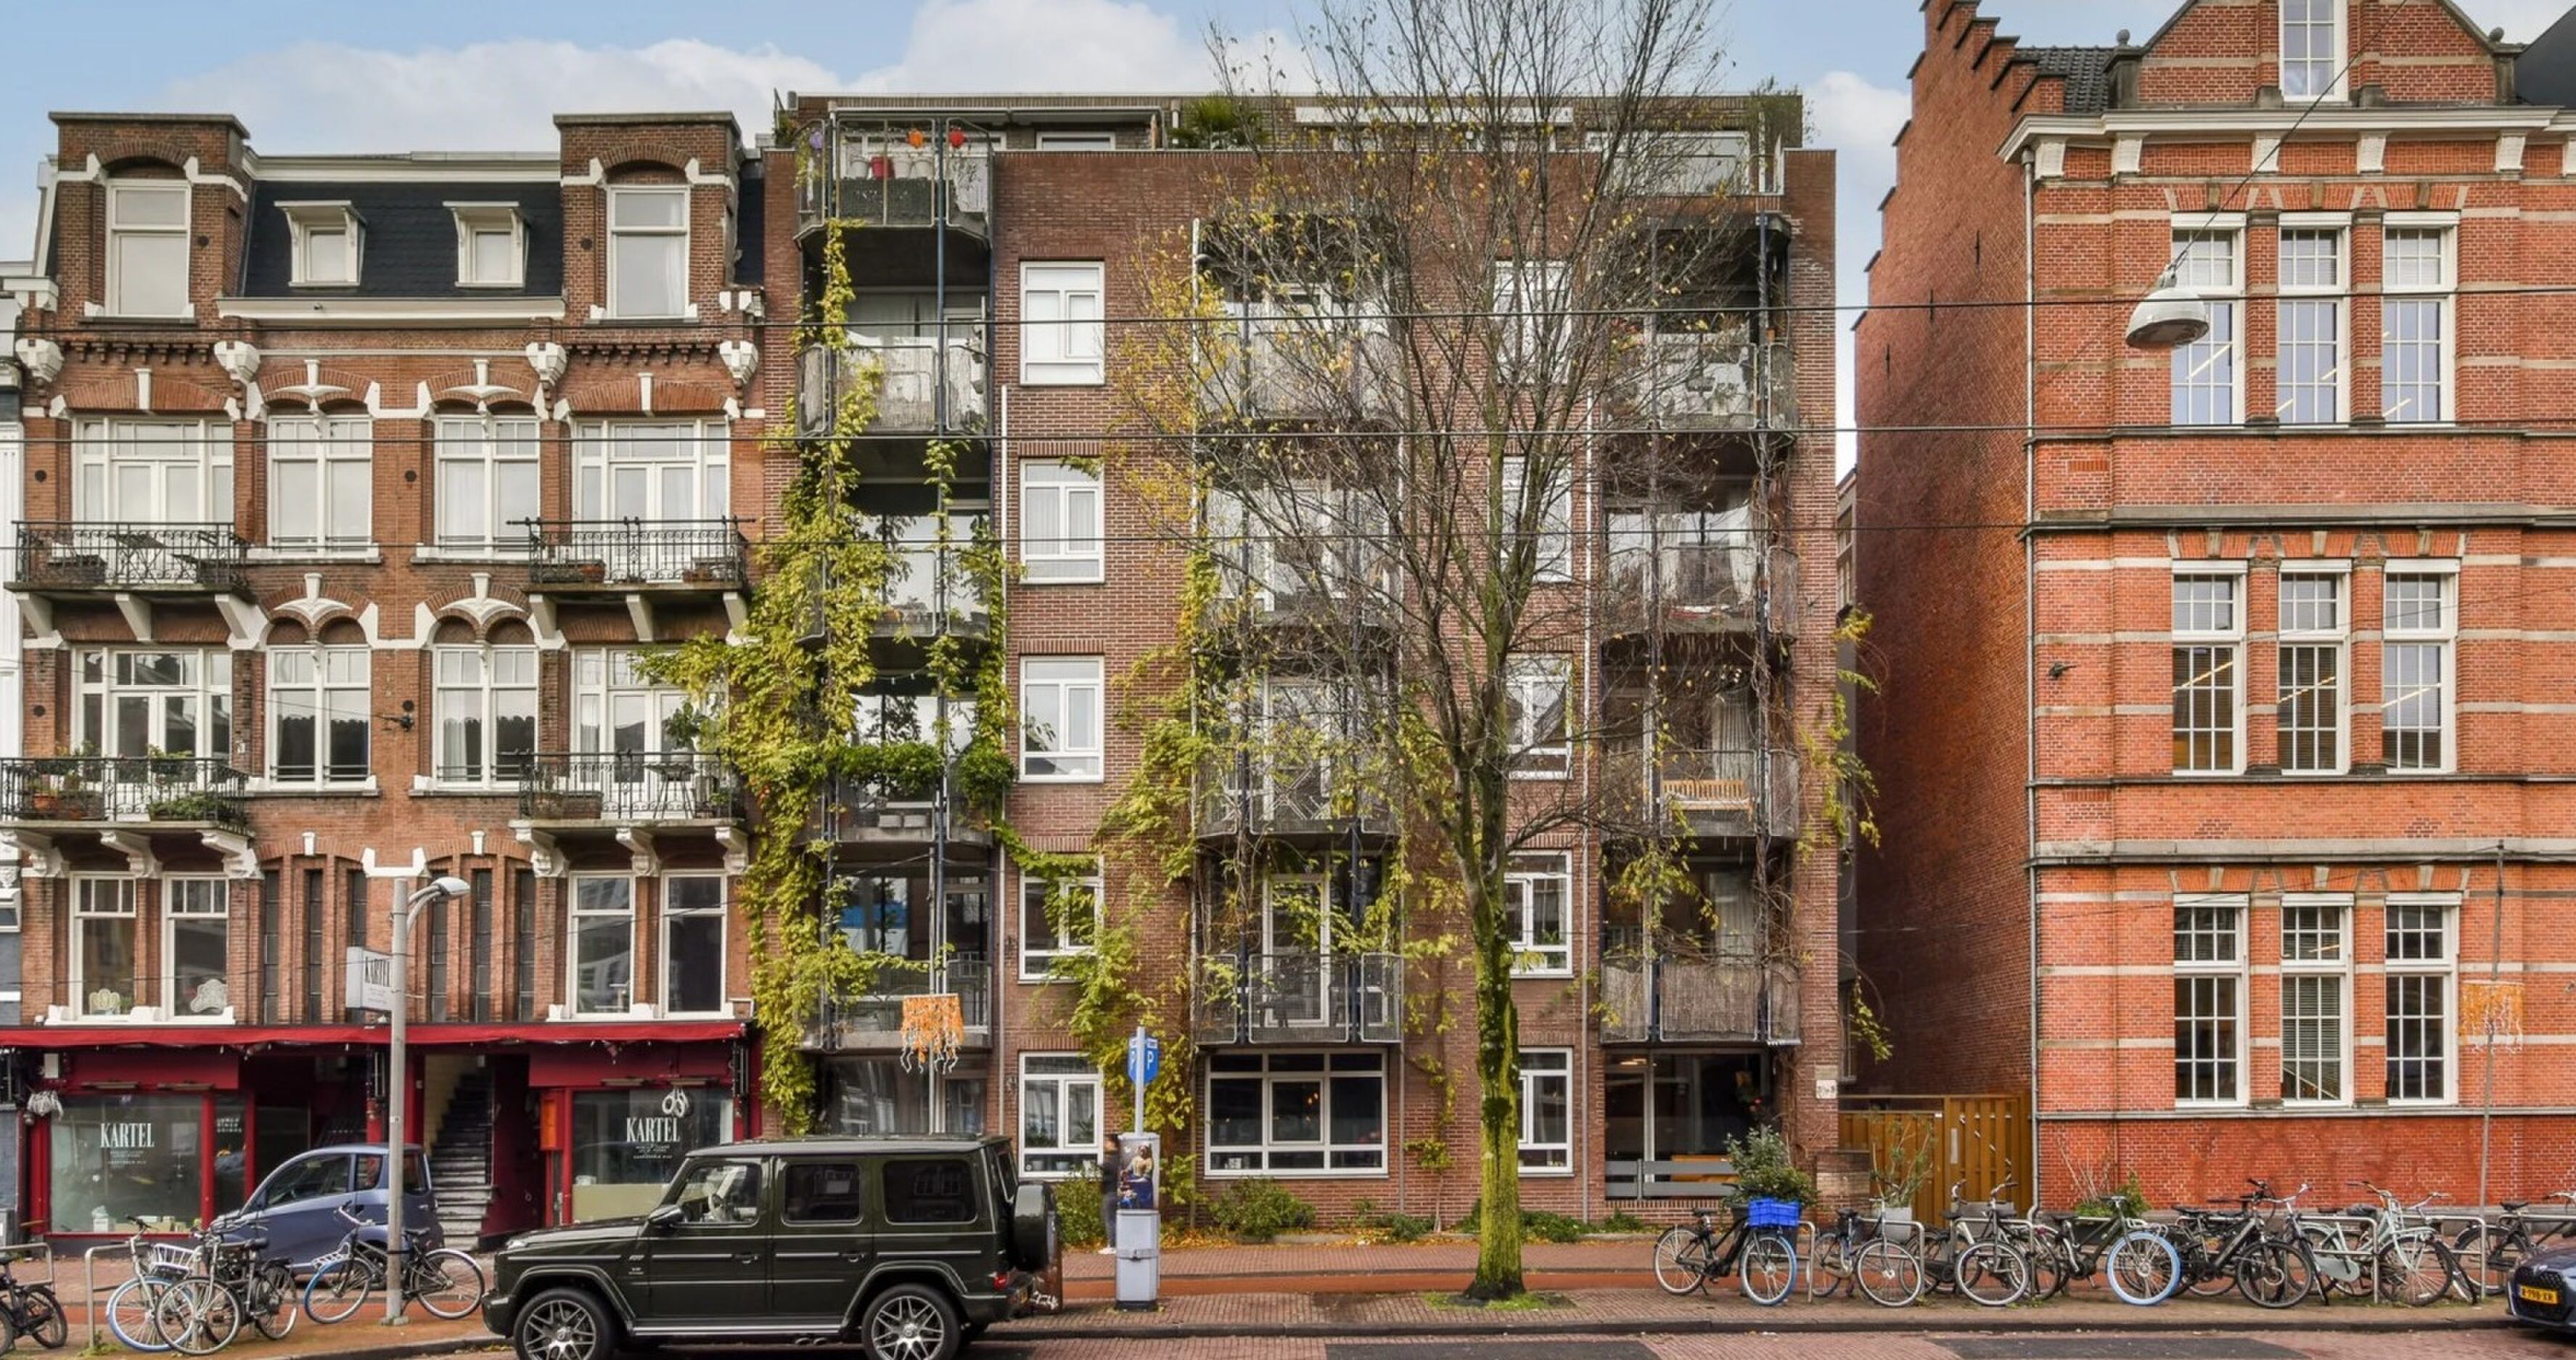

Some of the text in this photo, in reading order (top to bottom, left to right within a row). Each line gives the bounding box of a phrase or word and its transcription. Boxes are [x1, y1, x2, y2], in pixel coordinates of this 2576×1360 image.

[365, 956, 392, 987] KARTEL
[1147, 1050, 1154, 1070] P
[100, 1123, 155, 1147] KARTEL
[626, 1117, 681, 1142] KARTEL
